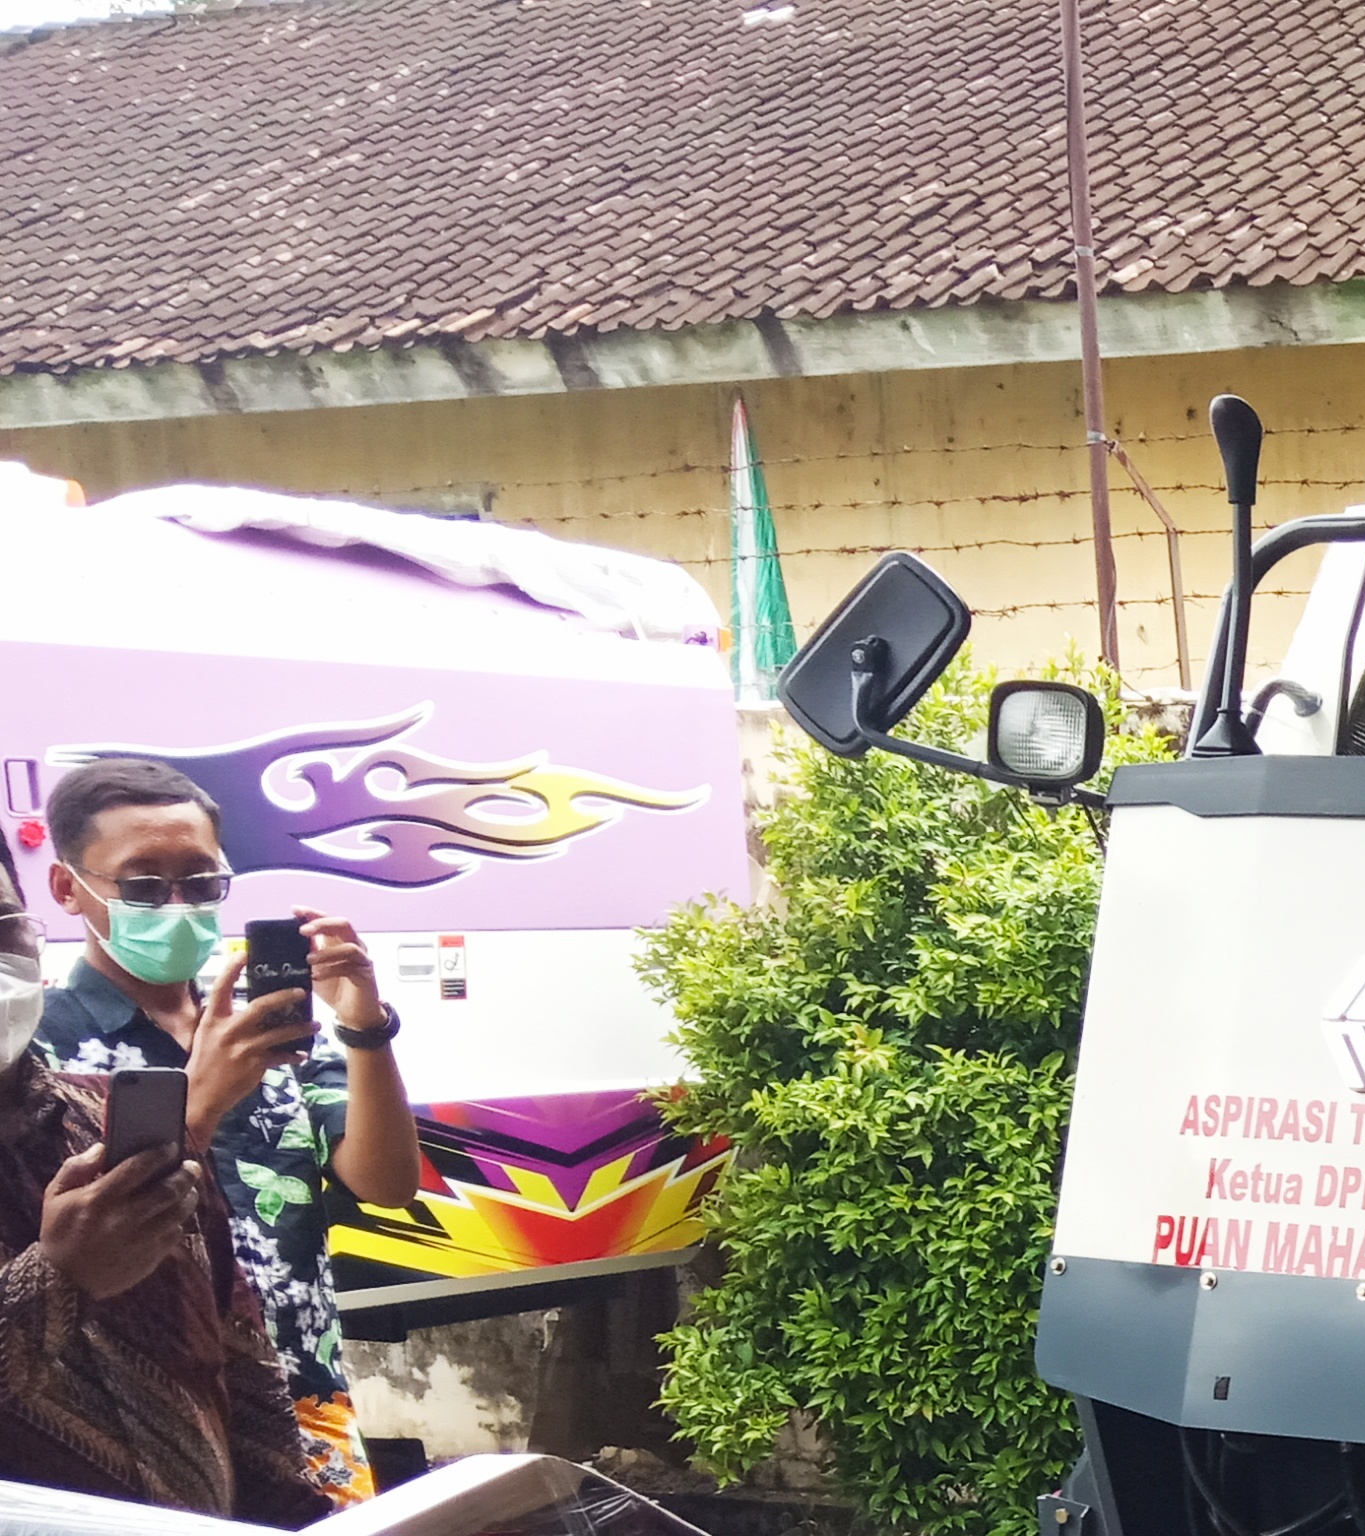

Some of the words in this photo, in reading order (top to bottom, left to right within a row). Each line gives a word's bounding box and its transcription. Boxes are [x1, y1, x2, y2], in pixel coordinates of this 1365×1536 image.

[1179, 1094, 1338, 1143] ASPIRASI
[1205, 1158, 1303, 1205] Ketua
[1152, 1214, 1252, 1271] PUAN
